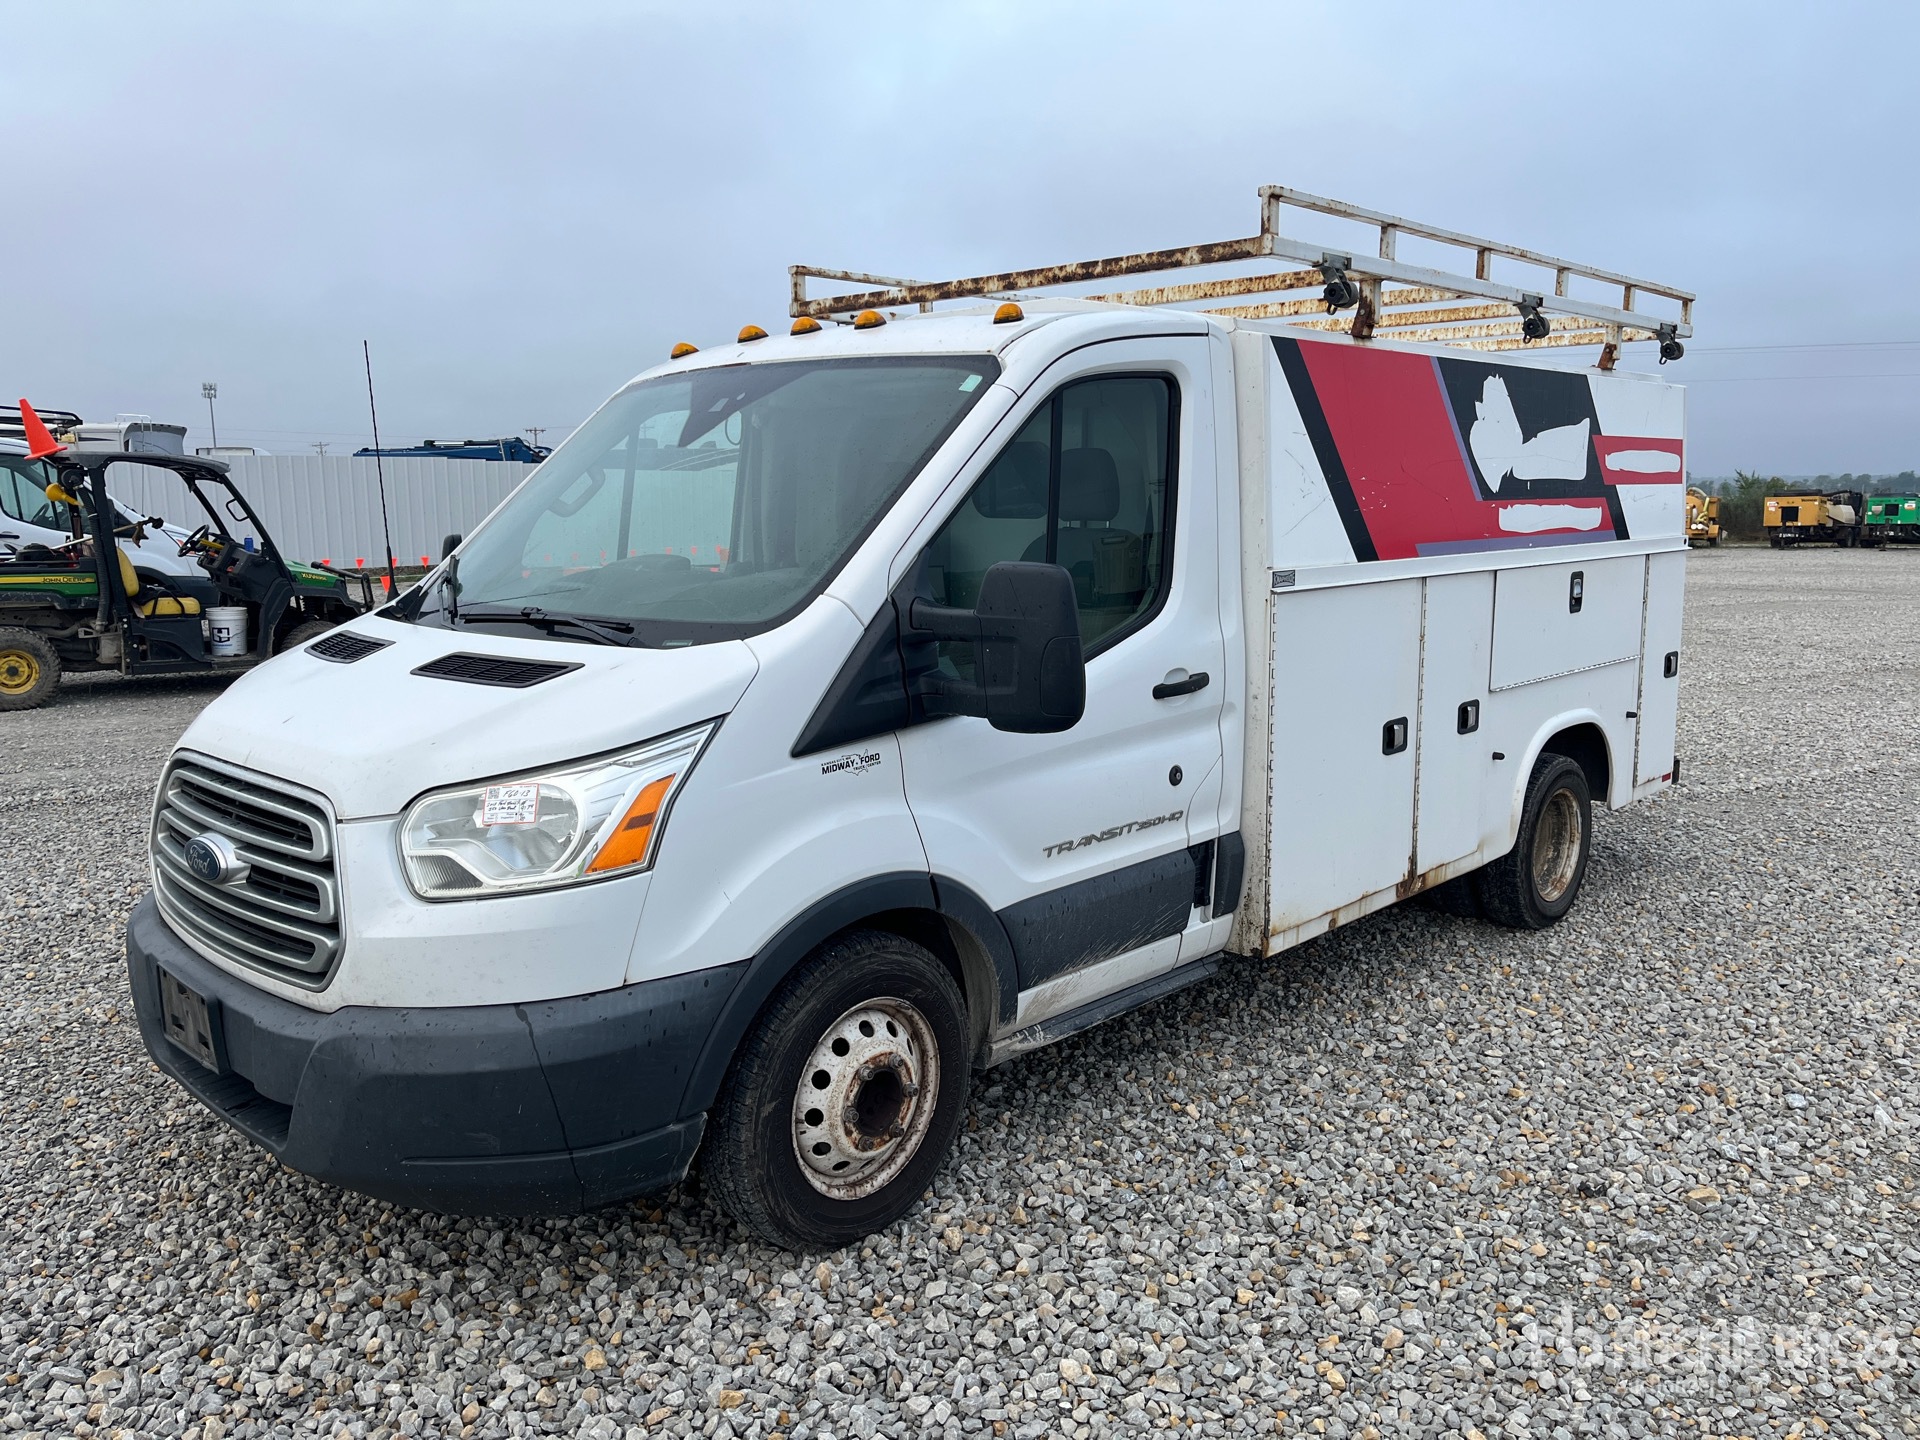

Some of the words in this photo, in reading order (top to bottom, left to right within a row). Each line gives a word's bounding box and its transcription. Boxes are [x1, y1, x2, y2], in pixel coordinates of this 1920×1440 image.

[821, 759, 855, 775] MIDWAY
[860, 753, 880, 764] FORD
[1043, 820, 1139, 858] TRANSIT
[188, 844, 211, 875] Ford
